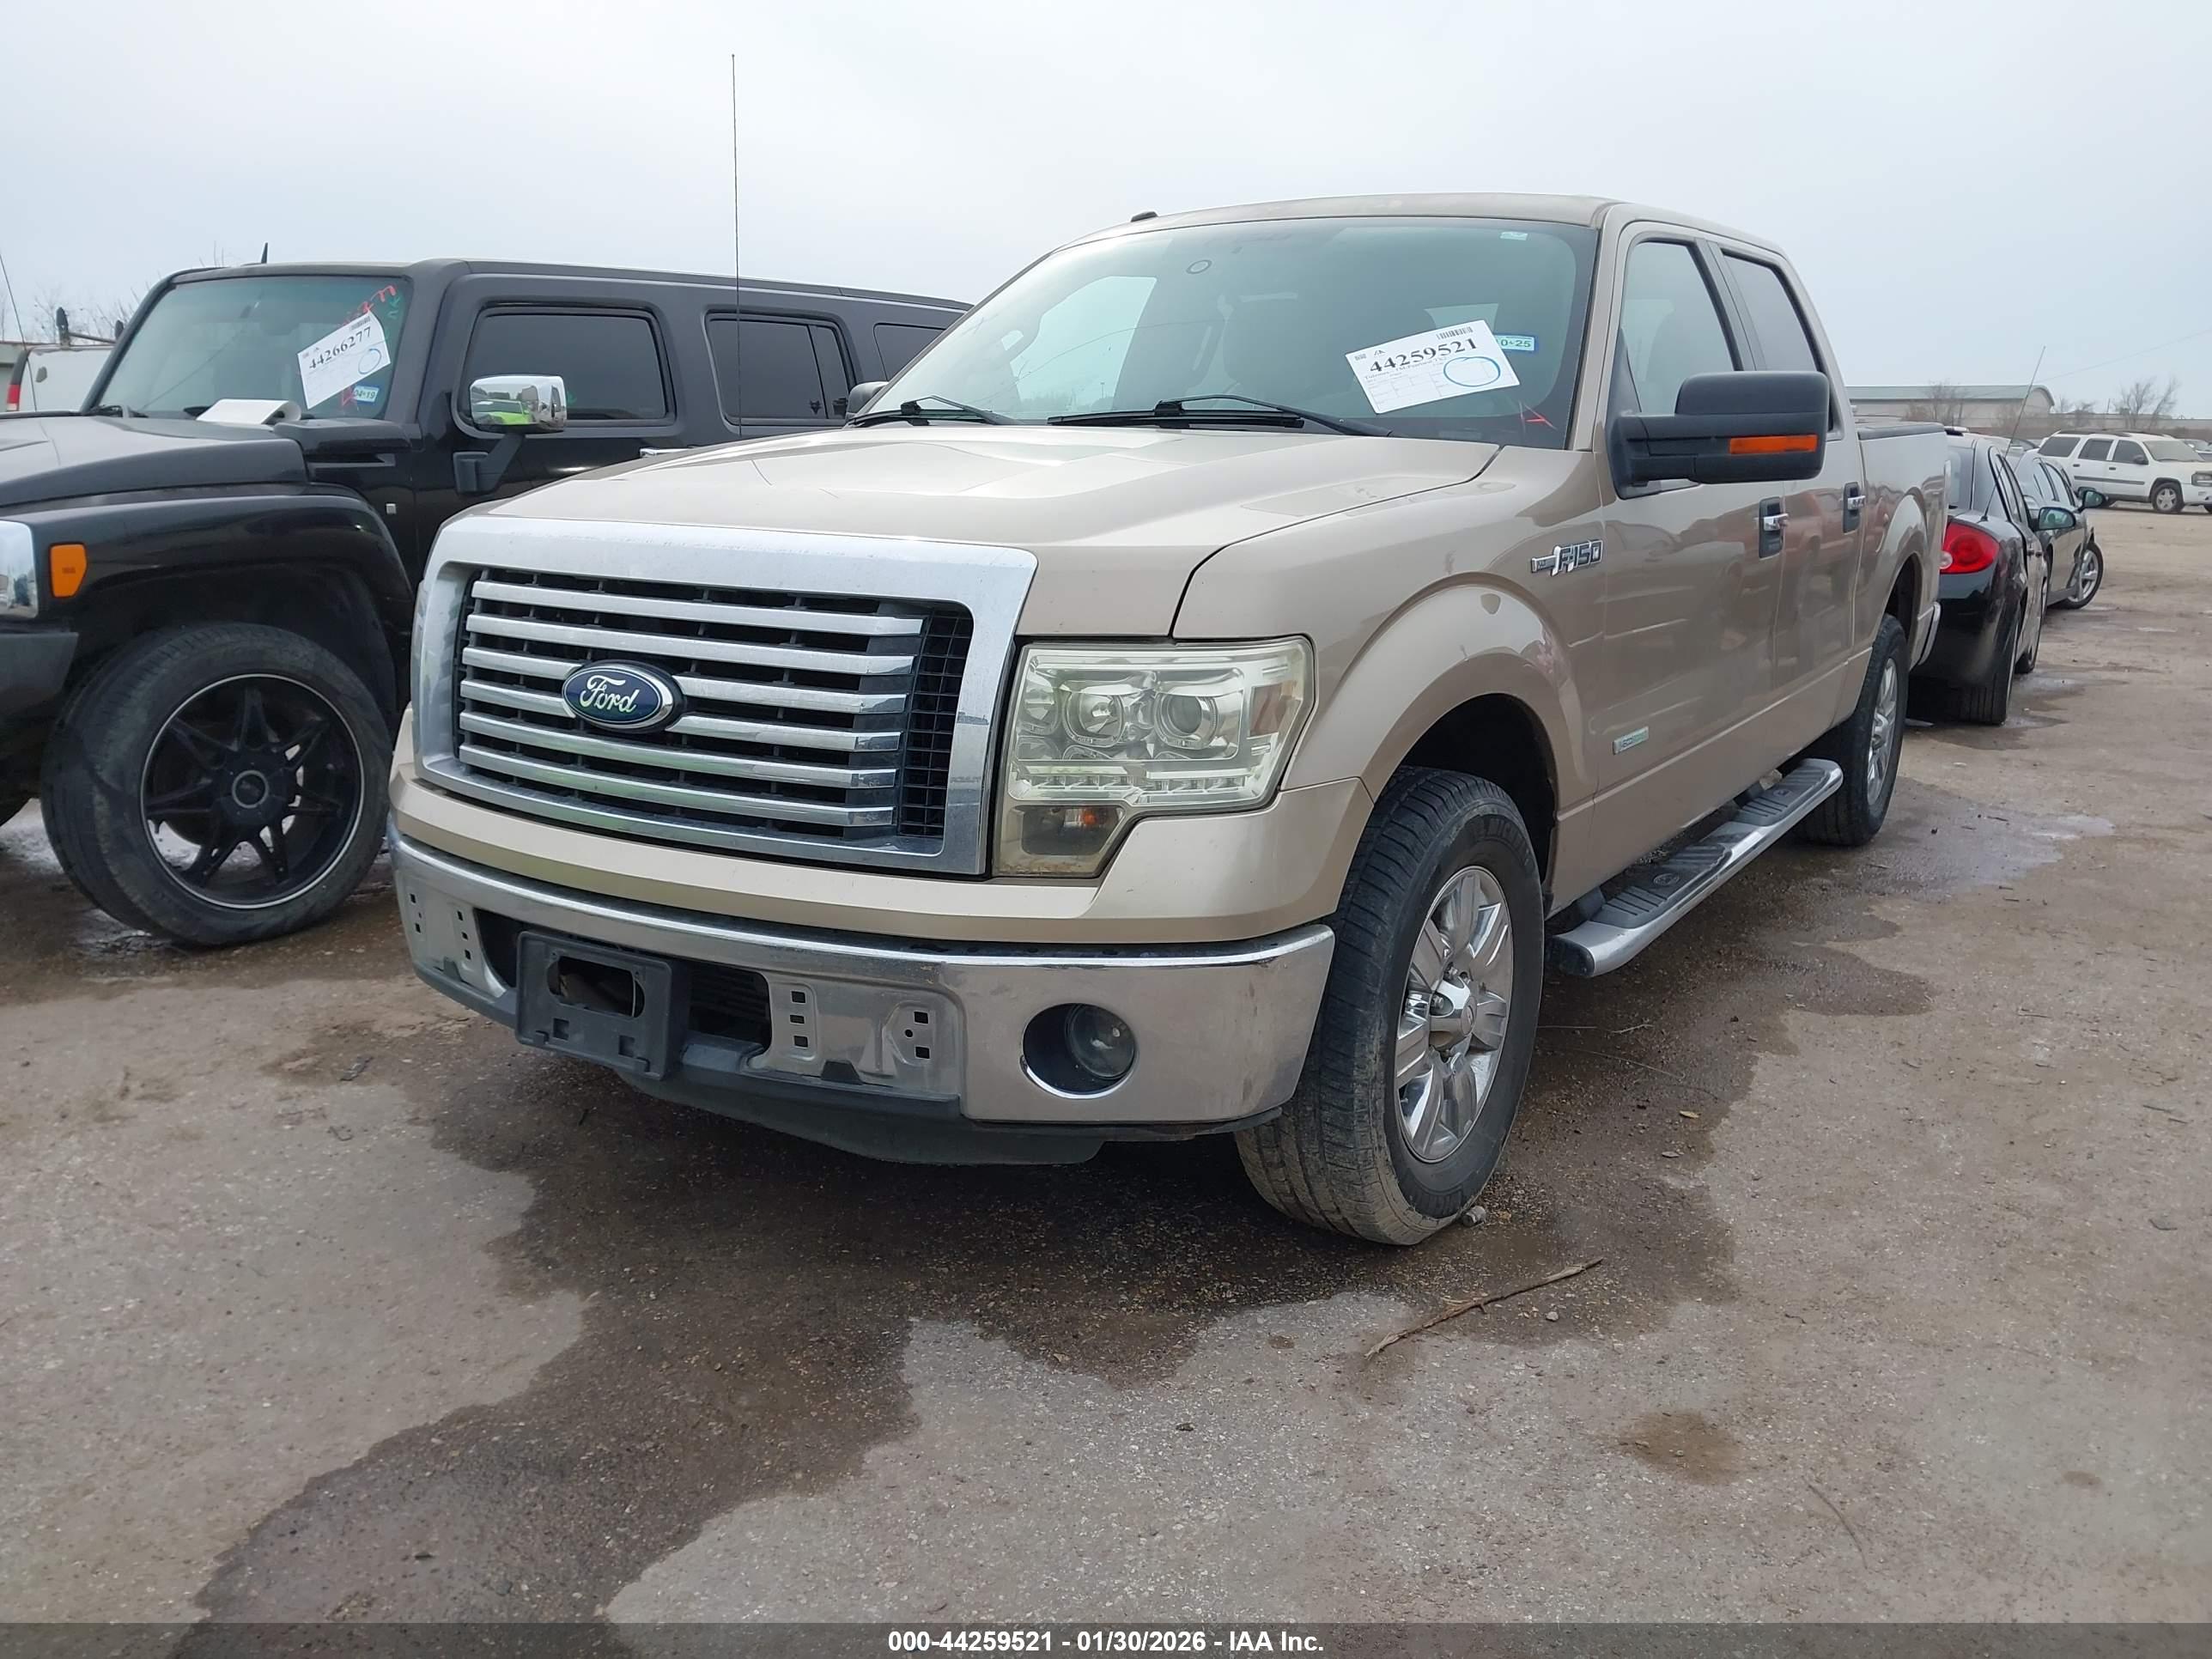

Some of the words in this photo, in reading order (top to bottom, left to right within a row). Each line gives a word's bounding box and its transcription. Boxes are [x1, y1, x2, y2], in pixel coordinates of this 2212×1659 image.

[309, 326, 371, 370] 44266277
[1370, 337, 1478, 373] 44259521
[579, 674, 641, 714] Ford
